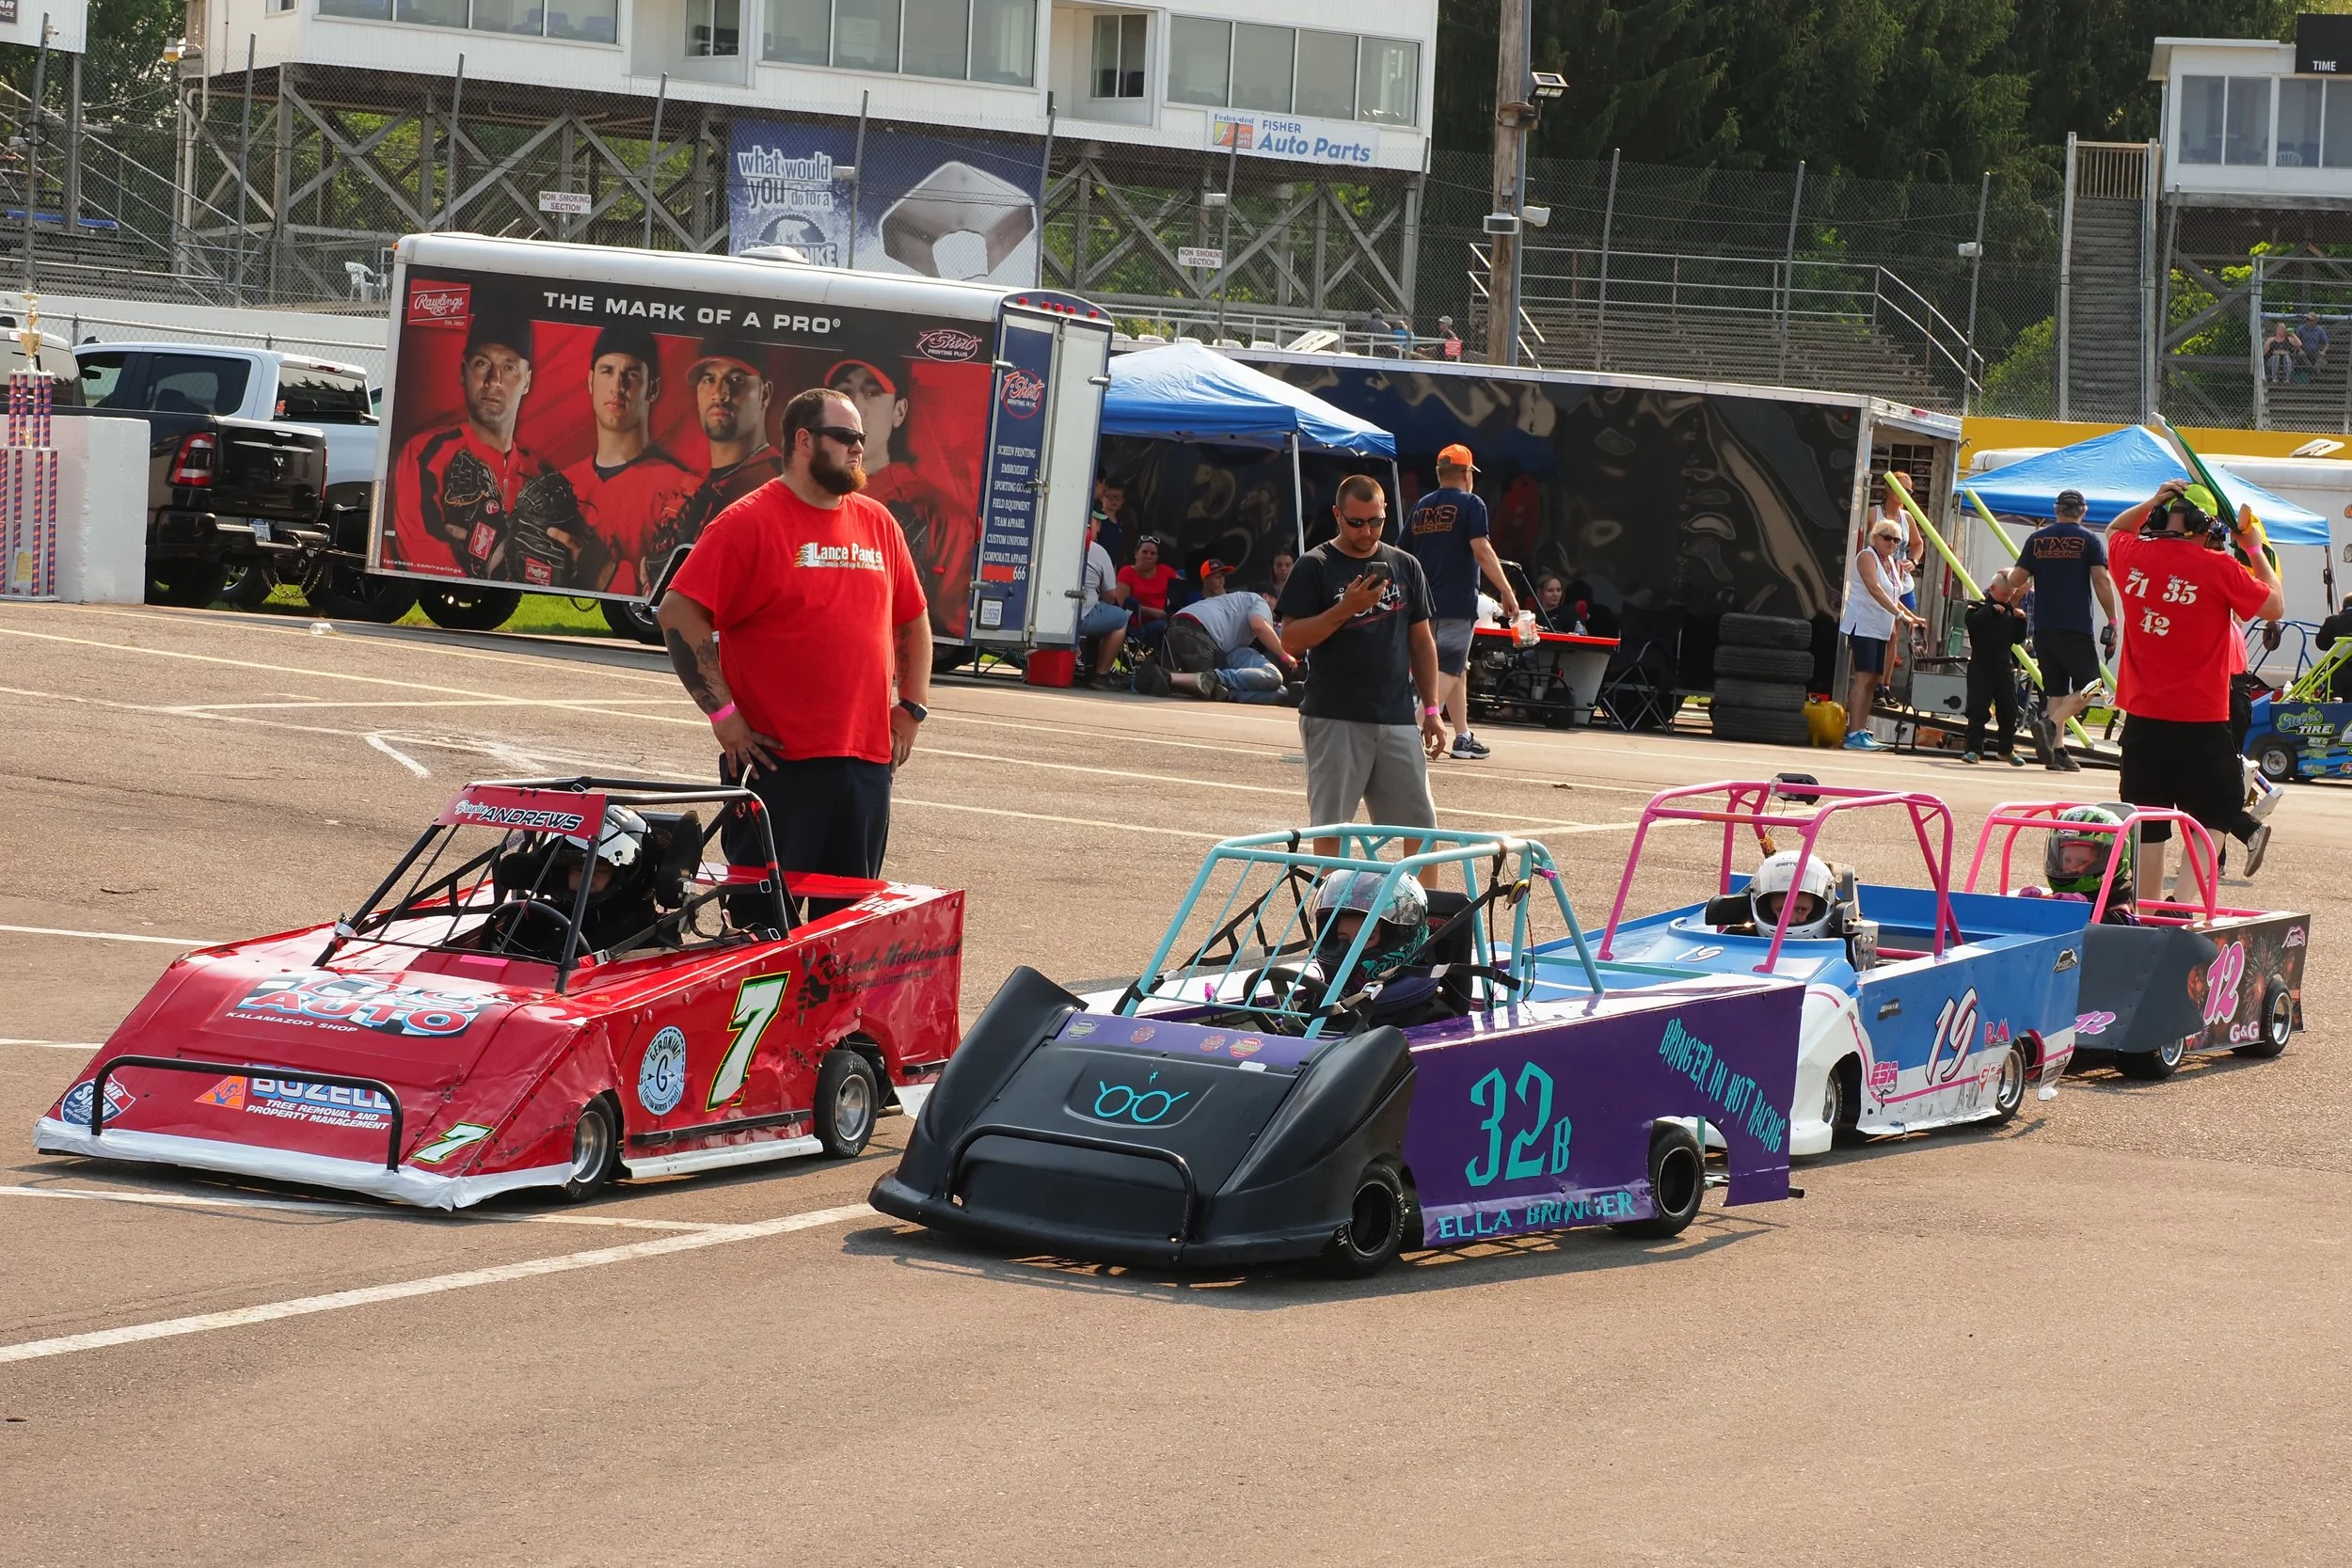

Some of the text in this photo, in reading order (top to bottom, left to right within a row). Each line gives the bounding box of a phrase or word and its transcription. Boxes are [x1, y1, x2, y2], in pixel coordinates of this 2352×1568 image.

[2312, 60, 2337, 71] TIME
[1263, 119, 1301, 134] FISHER
[1258, 132, 1371, 162] Auto Parts
[739, 148, 829, 181] what would
[559, 194, 590, 204] SMOKING
[750, 178, 785, 209] you
[805, 191, 821, 206] for
[550, 202, 581, 212] SECTION
[1180, 248, 1222, 260] NON SMOKING
[1188, 257, 1216, 266] SECTION
[414, 293, 464, 313] Rawlings
[543, 292, 595, 312] THE
[605, 297, 686, 322] MARK
[697, 308, 732, 325] OF
[742, 311, 761, 328] A
[928, 348, 952, 356] PRINTING
[997, 445, 1036, 459] SCREEN PRINTING
[1001, 464, 1029, 476] EMBROIDERY
[993, 481, 1016, 492] SPORTING
[993, 498, 1031, 512] FIELD EQUIPMENT
[994, 516, 1025, 529] TEAM APPAREL
[987, 534, 1029, 546] CUSTOM UNIFORMS
[810, 542, 849, 564] Lance
[983, 551, 1027, 564] CORPORATE APPAREL
[383, 558, 462, 574] facebook.com/rawlings
[1012, 565, 1026, 580] 666
[2124, 574, 2150, 598] 71
[2162, 582, 2199, 605] 35
[2139, 614, 2170, 637] 42
[2298, 725, 2332, 734] TIRE
[478, 807, 584, 832] ANDREWS
[2202, 941, 2245, 1026] 12
[225, 1011, 358, 1033] KALAMAZOO SHOP
[240, 990, 471, 1034] AUTO
[2074, 1010, 2117, 1035] 12
[707, 972, 789, 1112] 7
[1926, 986, 1979, 1085] 19
[649, 1036, 681, 1062] GERONIMO
[656, 1053, 669, 1093] G
[1659, 1017, 1787, 1157] BRINGER IN HOT RACING
[246, 1104, 390, 1131] PROPERTY MANAGEMENT
[266, 1099, 380, 1121] TREE REMOVAL AND
[412, 1123, 492, 1164] 7
[1438, 1190, 1637, 1240] ELLA BRINGER
